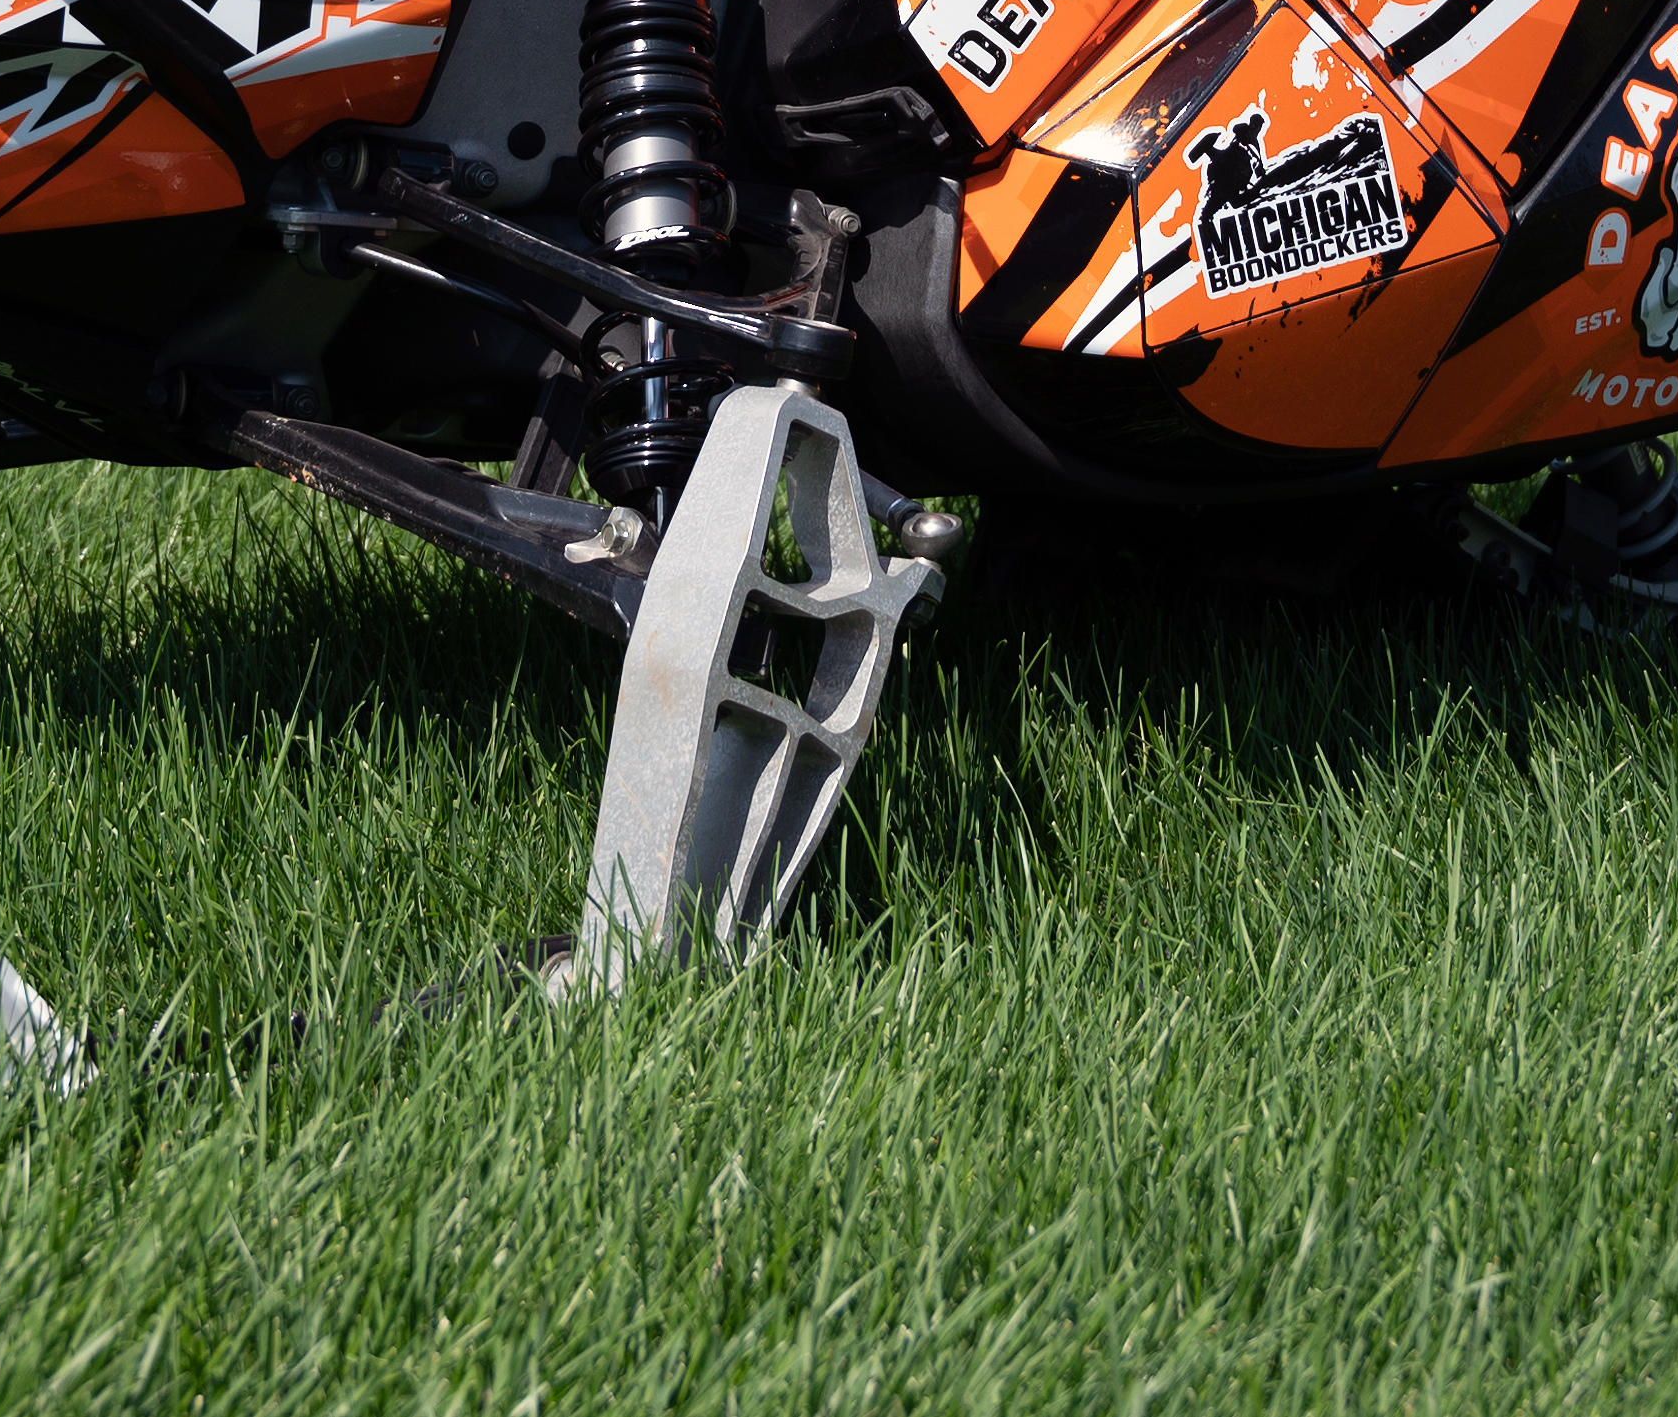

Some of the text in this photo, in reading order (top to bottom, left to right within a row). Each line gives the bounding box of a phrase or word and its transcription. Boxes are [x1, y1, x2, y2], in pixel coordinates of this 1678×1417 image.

[1198, 174, 1399, 270] MICHIGAN
[1208, 220, 1404, 293] BOONDOCKERS
[1574, 309, 1621, 335] EST.
